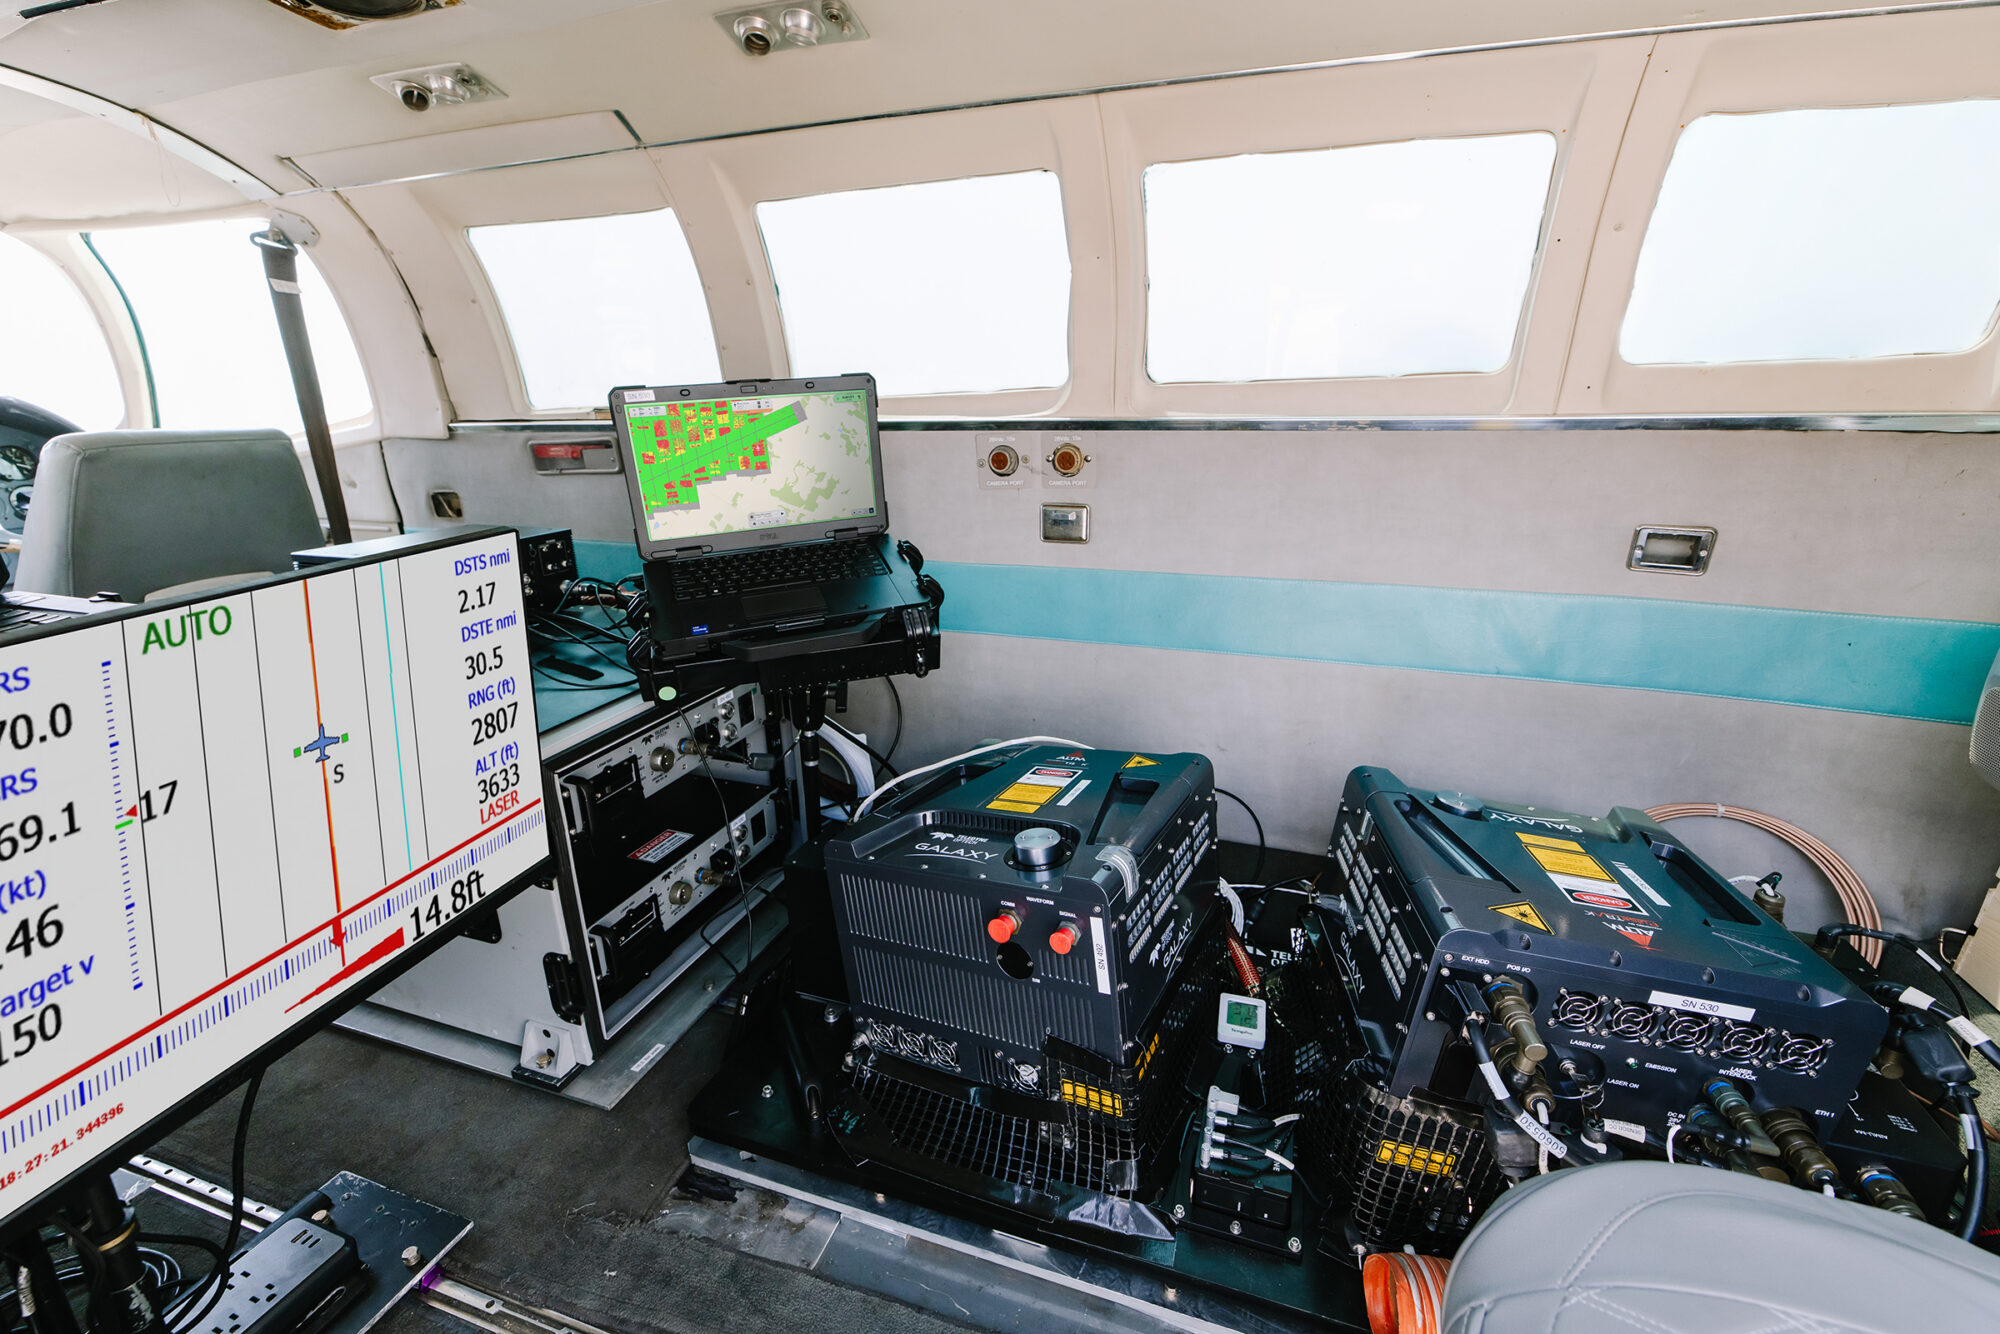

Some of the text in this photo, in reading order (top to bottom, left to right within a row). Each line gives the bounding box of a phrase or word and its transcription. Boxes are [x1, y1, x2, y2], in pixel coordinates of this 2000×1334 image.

[454, 548, 511, 576] DSTS nmi
[458, 581, 496, 614] 2.17
[142, 605, 233, 654] AUTO
[461, 610, 517, 643] DSTE nmi
[465, 645, 504, 680] 30.5
[468, 676, 516, 709] RNG (ft)
[471, 701, 518, 746] 2807
[475, 741, 520, 776] ALT (ft)
[333, 763, 345, 784] S
[477, 763, 521, 804] 3633
[140, 779, 178, 824] 17
[480, 789, 520, 825] LASER
[1489, 812, 1584, 833] GALAXY
[958, 834, 989, 843] TELEDYNE
[914, 842, 999, 860] GALAXY
[410, 869, 487, 942] 14.8ft
[1026, 896, 1055, 906] WAVEFORM
[1580, 894, 1624, 906] DANGER
[1059, 910, 1078, 919] SIGNAL
[0, 903, 64, 971] 46
[1163, 912, 1193, 968] GALAXY
[1602, 921, 1654, 937] ALTM
[79, 955, 95, 975] v
[1095, 943, 1106, 971] SN 492
[1340, 931, 1366, 994] GALAXY
[1506, 963, 1521, 972] POS
[1681, 999, 1720, 1013] SN 530
[1569, 1039, 1592, 1049] LASER
[1645, 1062, 1678, 1073] EMISSION
[1718, 1069, 1758, 1081] INTERLOCK
[1730, 1066, 1753, 1075] LASER
[1607, 1078, 1629, 1087] LASER
[1815, 1109, 1829, 1117] ETH
[1519, 1116, 1566, 1155] 5060530
